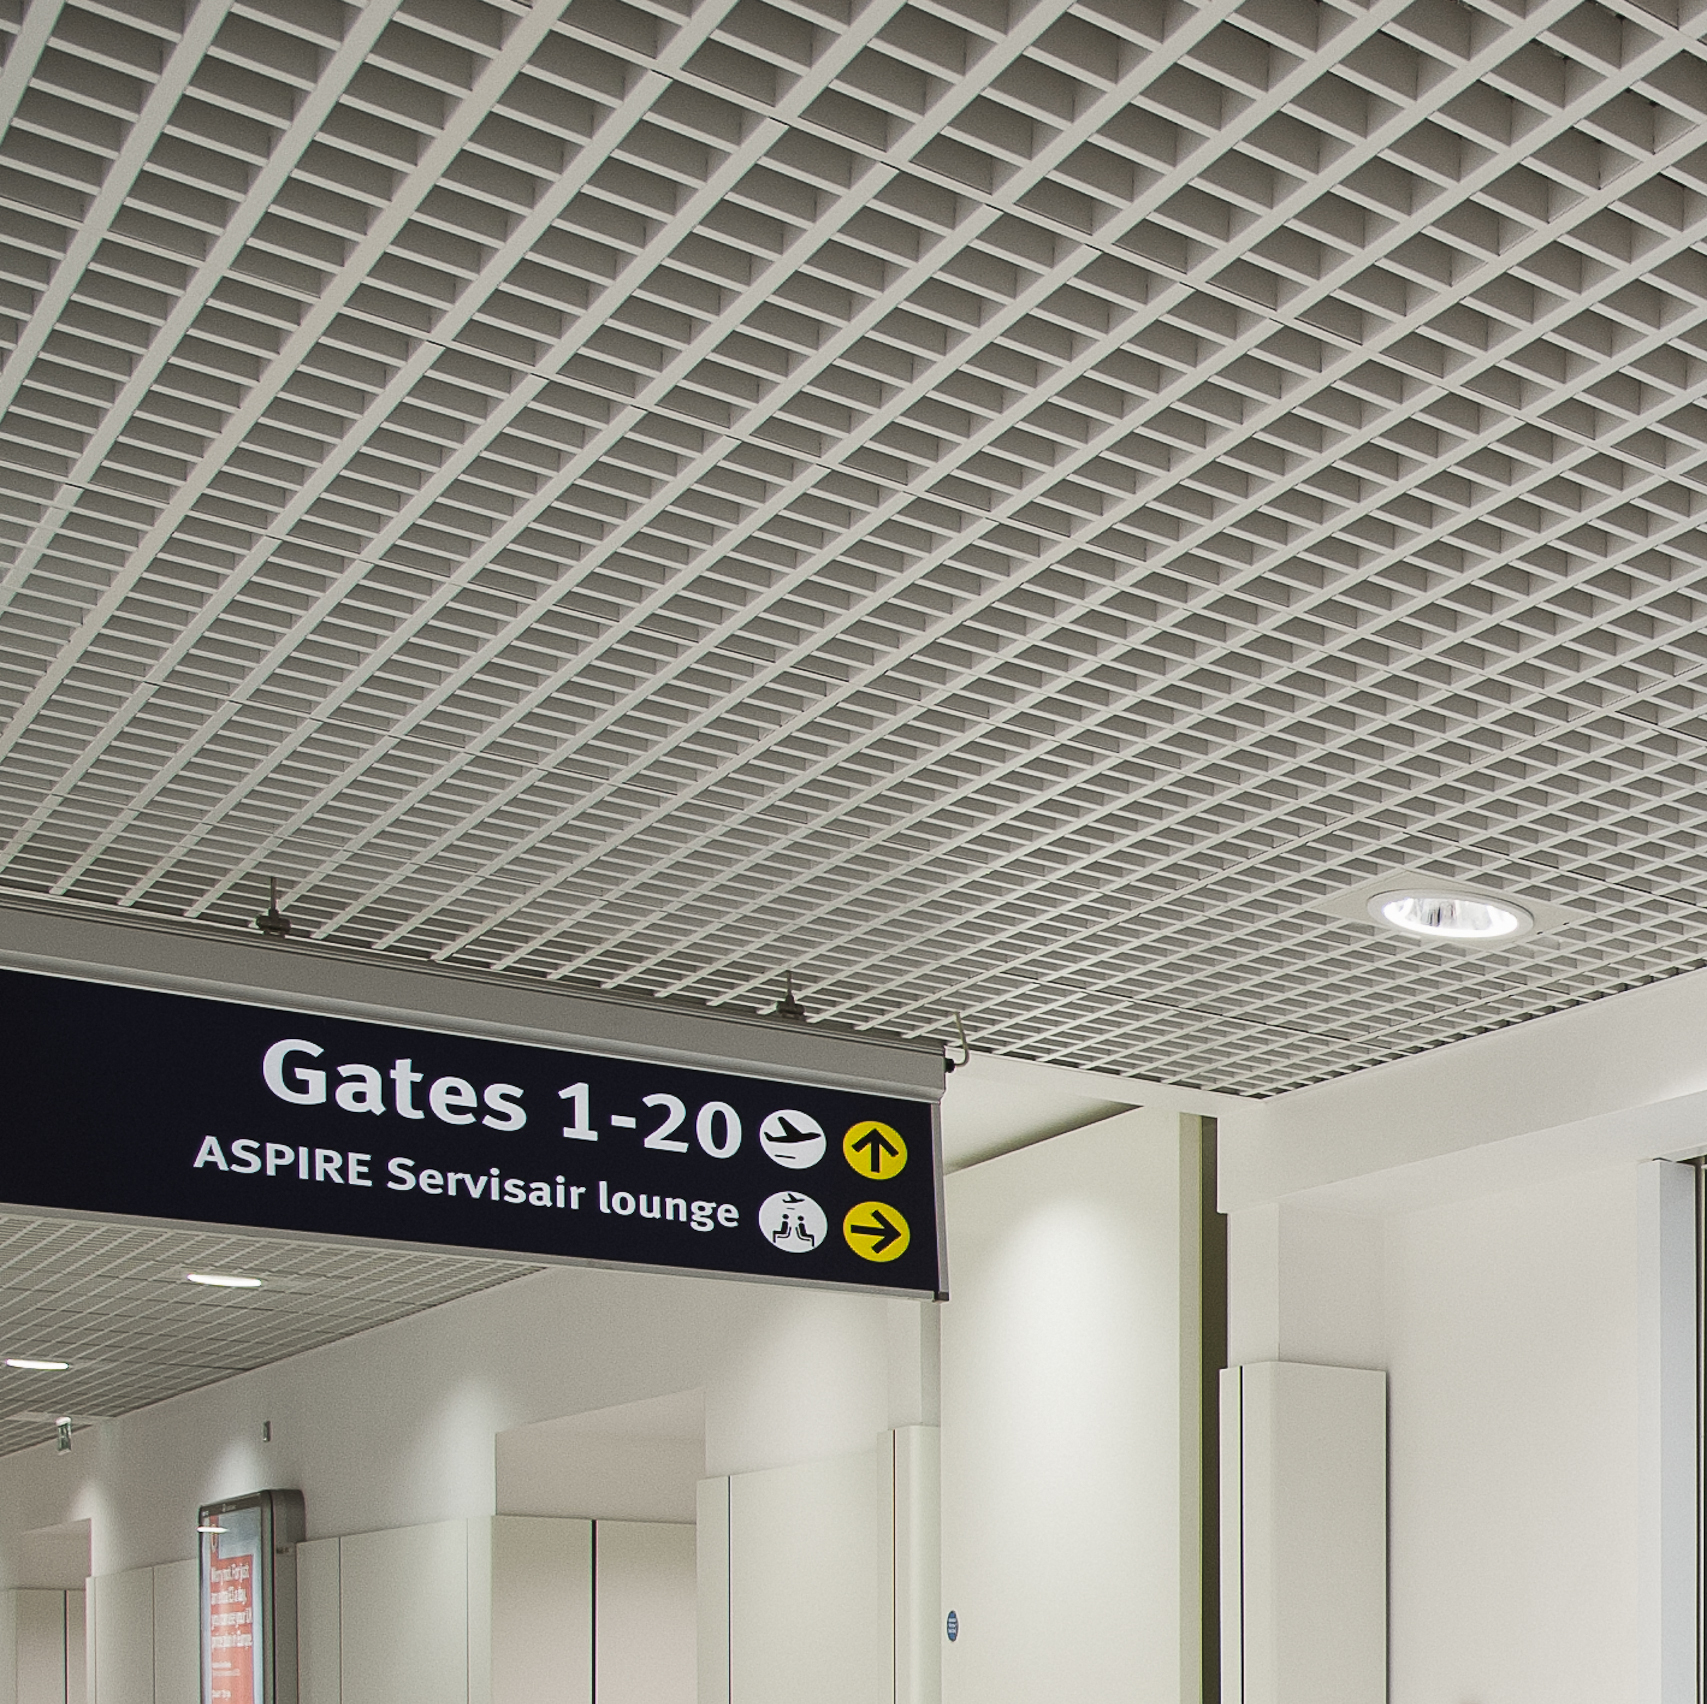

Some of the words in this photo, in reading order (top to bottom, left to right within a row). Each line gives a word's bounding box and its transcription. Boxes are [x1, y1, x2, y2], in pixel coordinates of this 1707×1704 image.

[263, 1039, 526, 1131] Gates
[558, 1083, 741, 1158] 1-20
[194, 1136, 372, 1186] ASPIRE
[387, 1157, 586, 1209] Servisair
[599, 1181, 739, 1231] lounge
